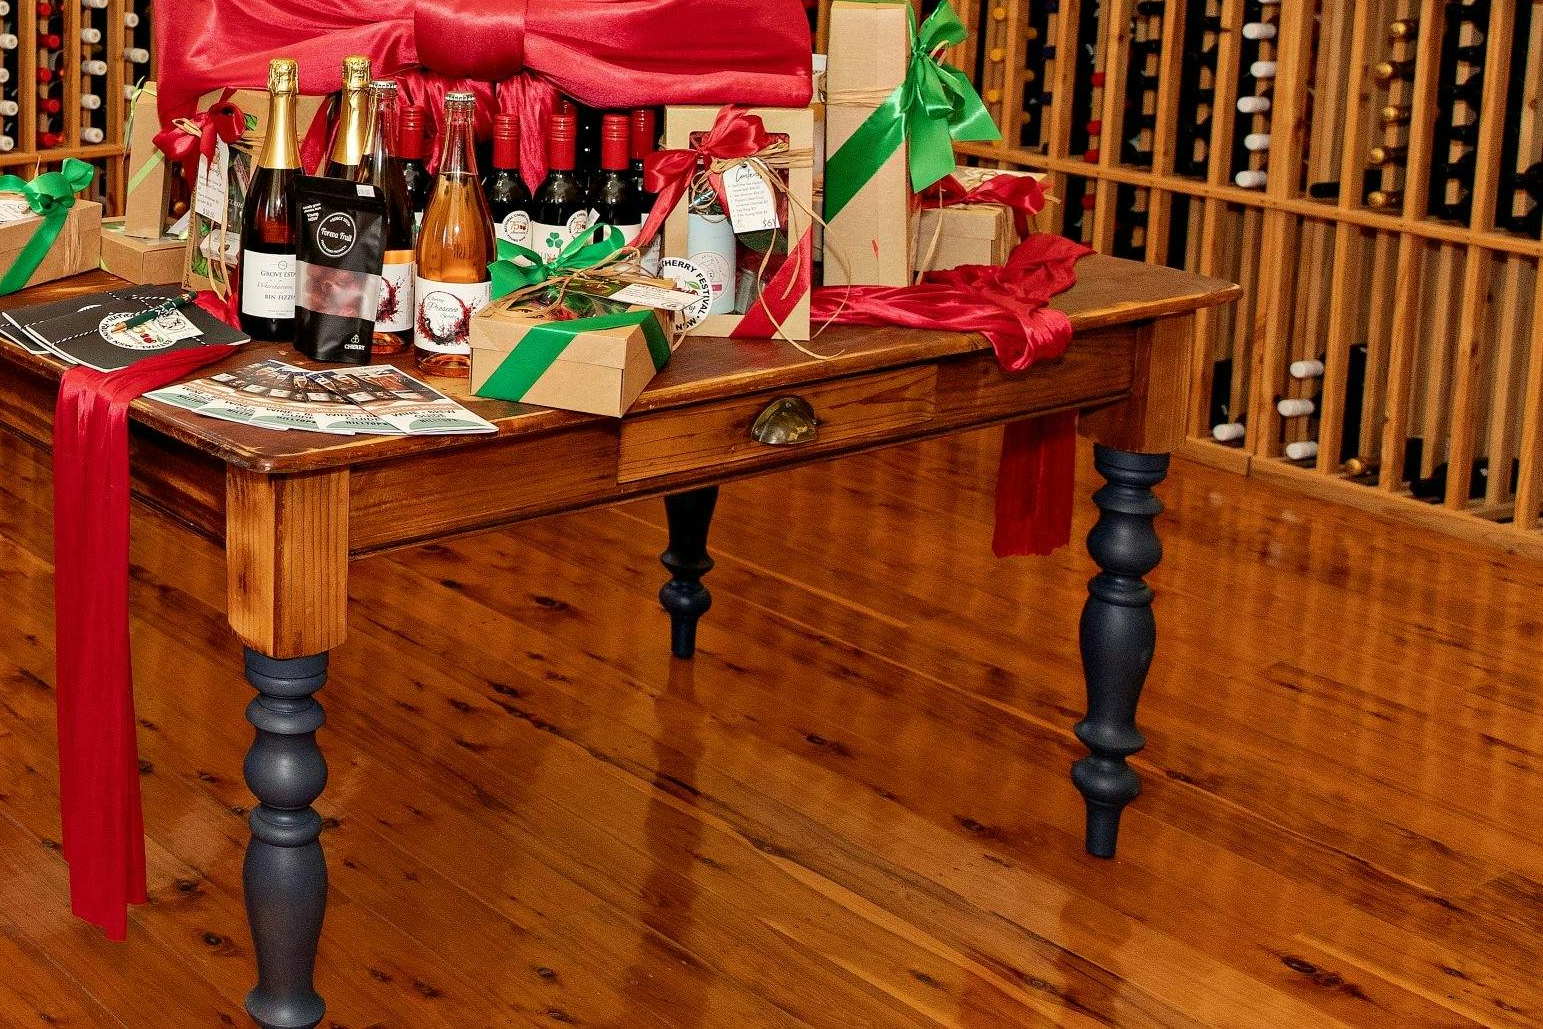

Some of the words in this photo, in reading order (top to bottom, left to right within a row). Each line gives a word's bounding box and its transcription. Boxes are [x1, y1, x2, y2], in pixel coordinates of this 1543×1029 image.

[260, 269, 284, 278] GROVE
[695, 272, 710, 315] FESTIVAL
[343, 343, 366, 351] CHERRY
